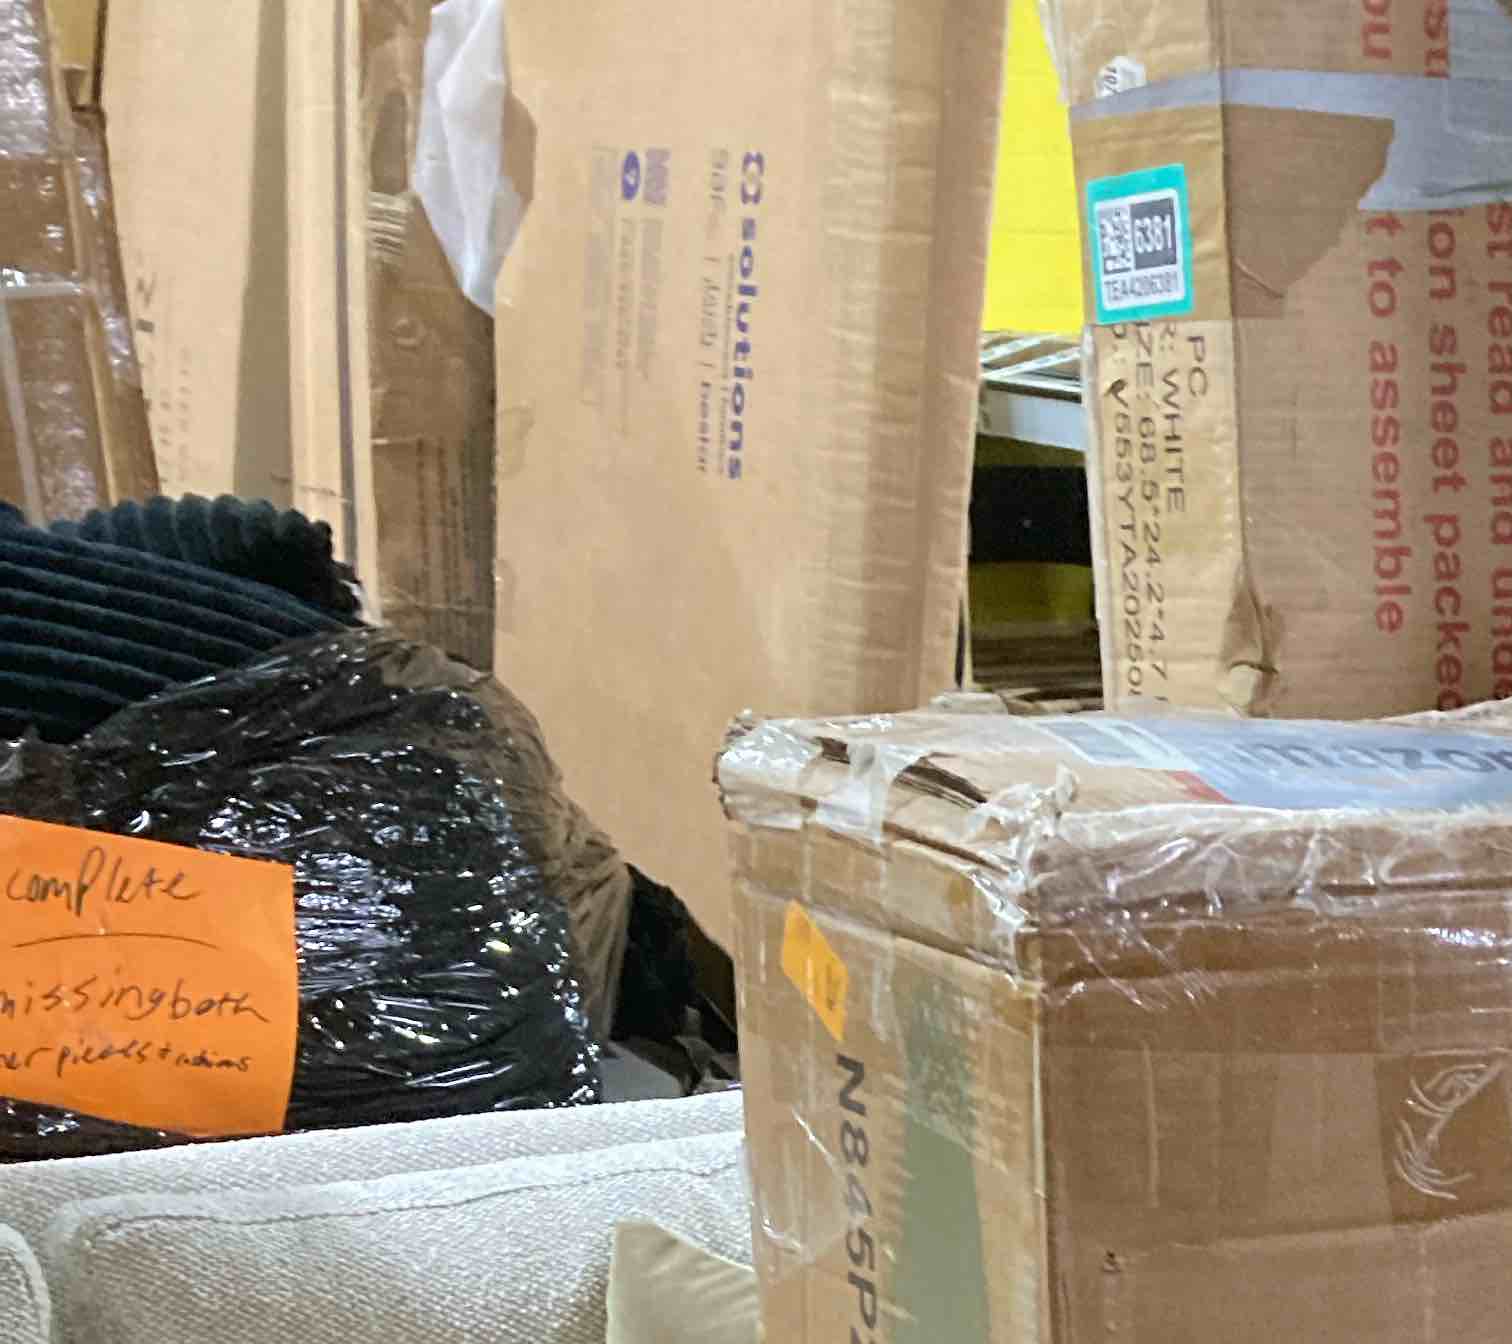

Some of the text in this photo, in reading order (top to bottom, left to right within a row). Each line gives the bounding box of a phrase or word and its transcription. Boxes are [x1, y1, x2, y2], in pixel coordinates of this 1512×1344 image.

[1133, 214, 1173, 253] 6381
[1367, 258, 1404, 319] to
[726, 217, 760, 480] solutions
[1430, 325, 1468, 493] sheet
[1160, 367, 1185, 514] WHITE
[1370, 341, 1412, 634] assemble
